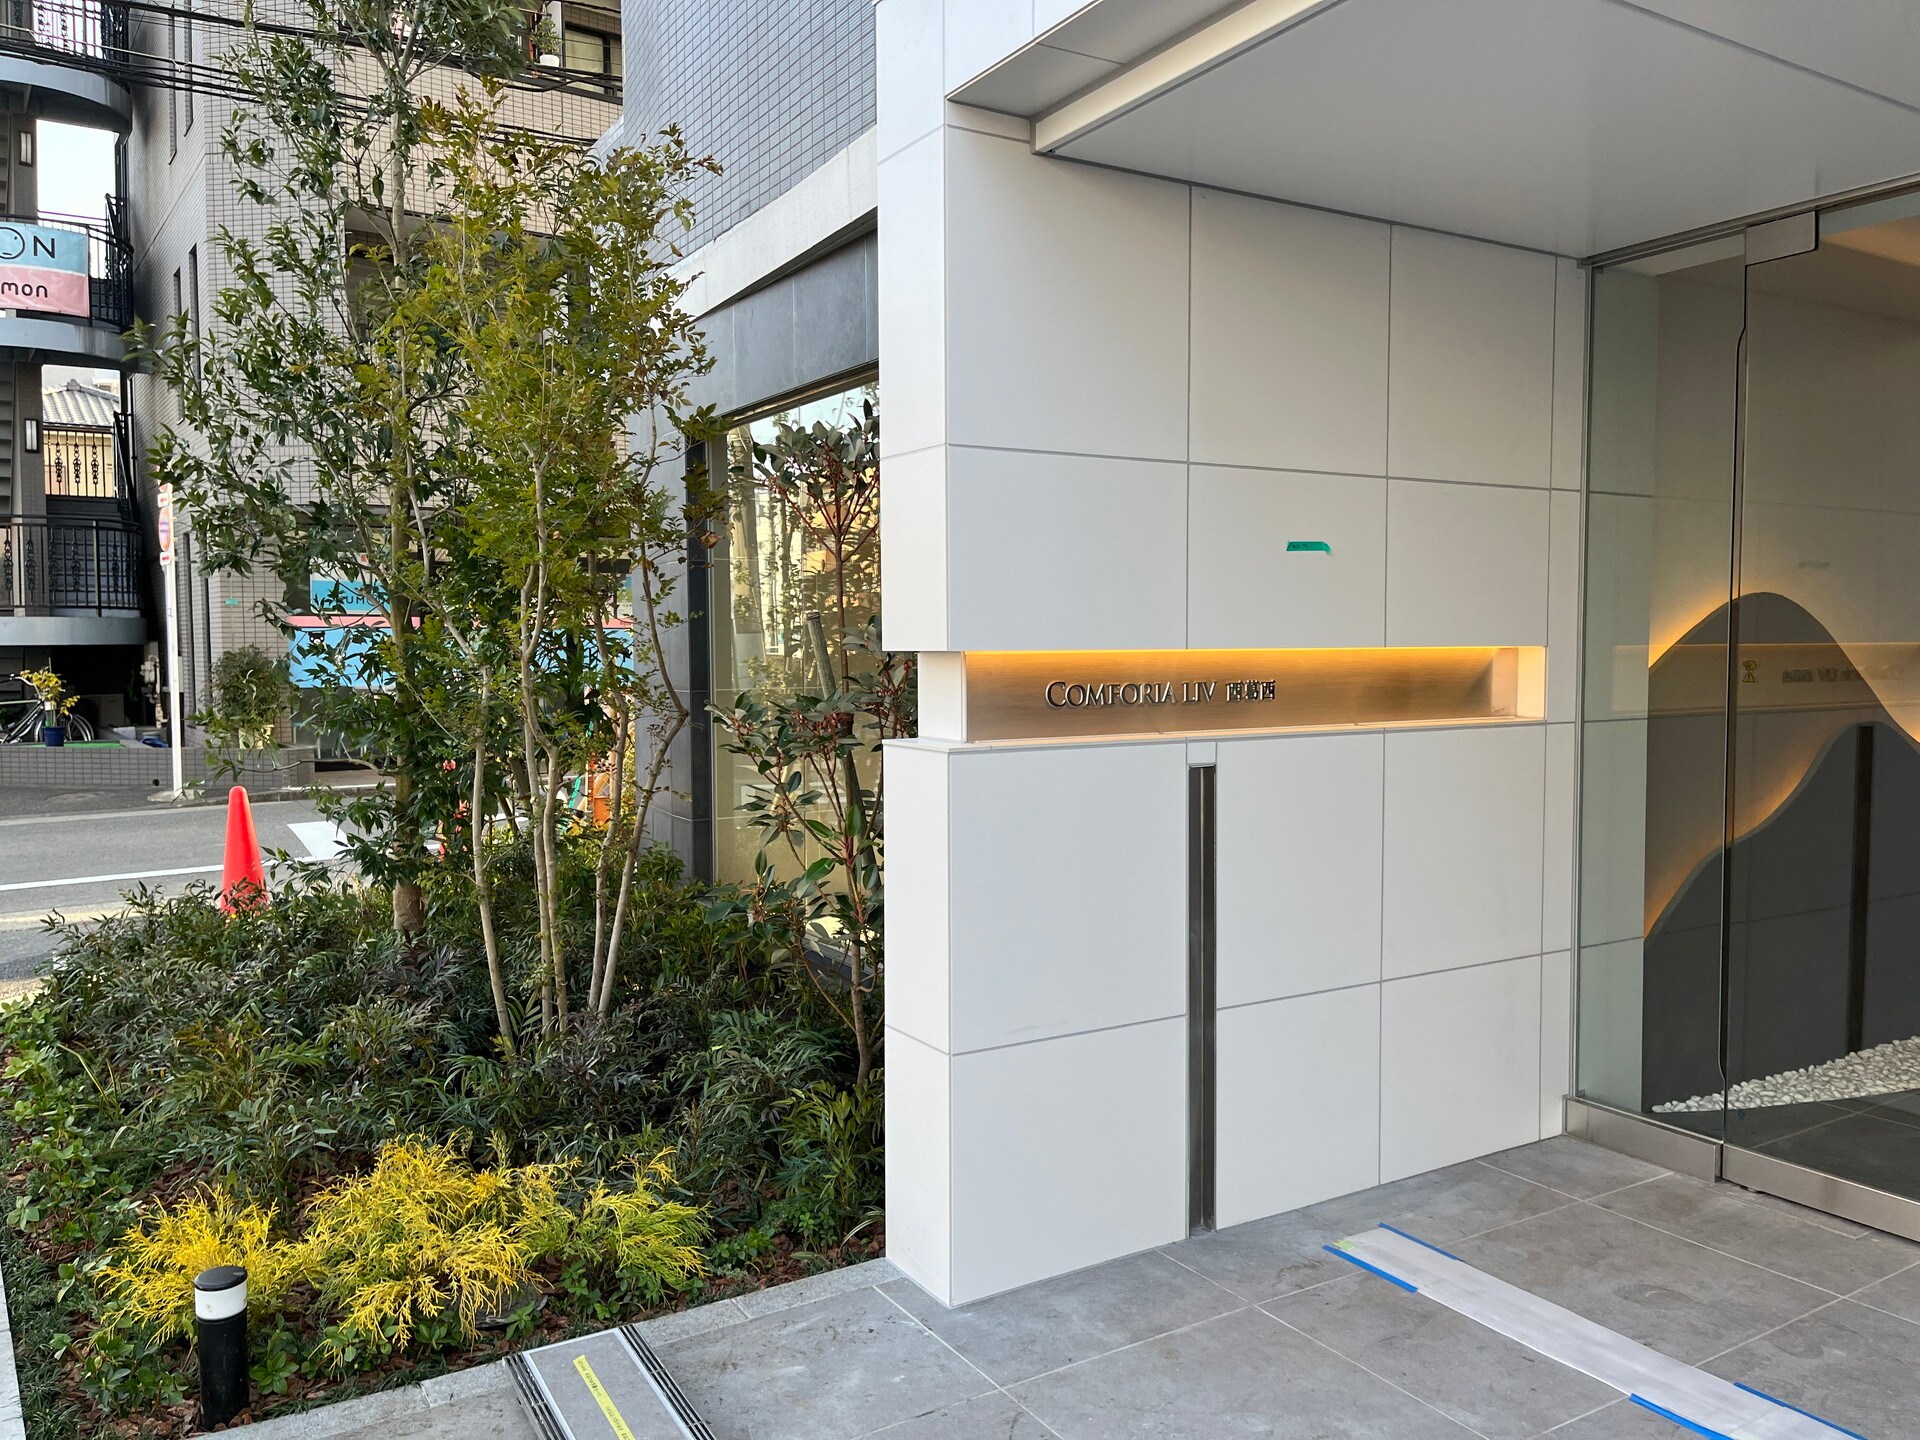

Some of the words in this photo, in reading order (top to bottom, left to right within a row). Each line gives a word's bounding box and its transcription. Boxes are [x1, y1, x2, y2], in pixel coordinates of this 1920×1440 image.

[1, 281, 48, 298] mon
[1045, 680, 1178, 708] COMFORIA
[1181, 680, 1218, 702] LIV
